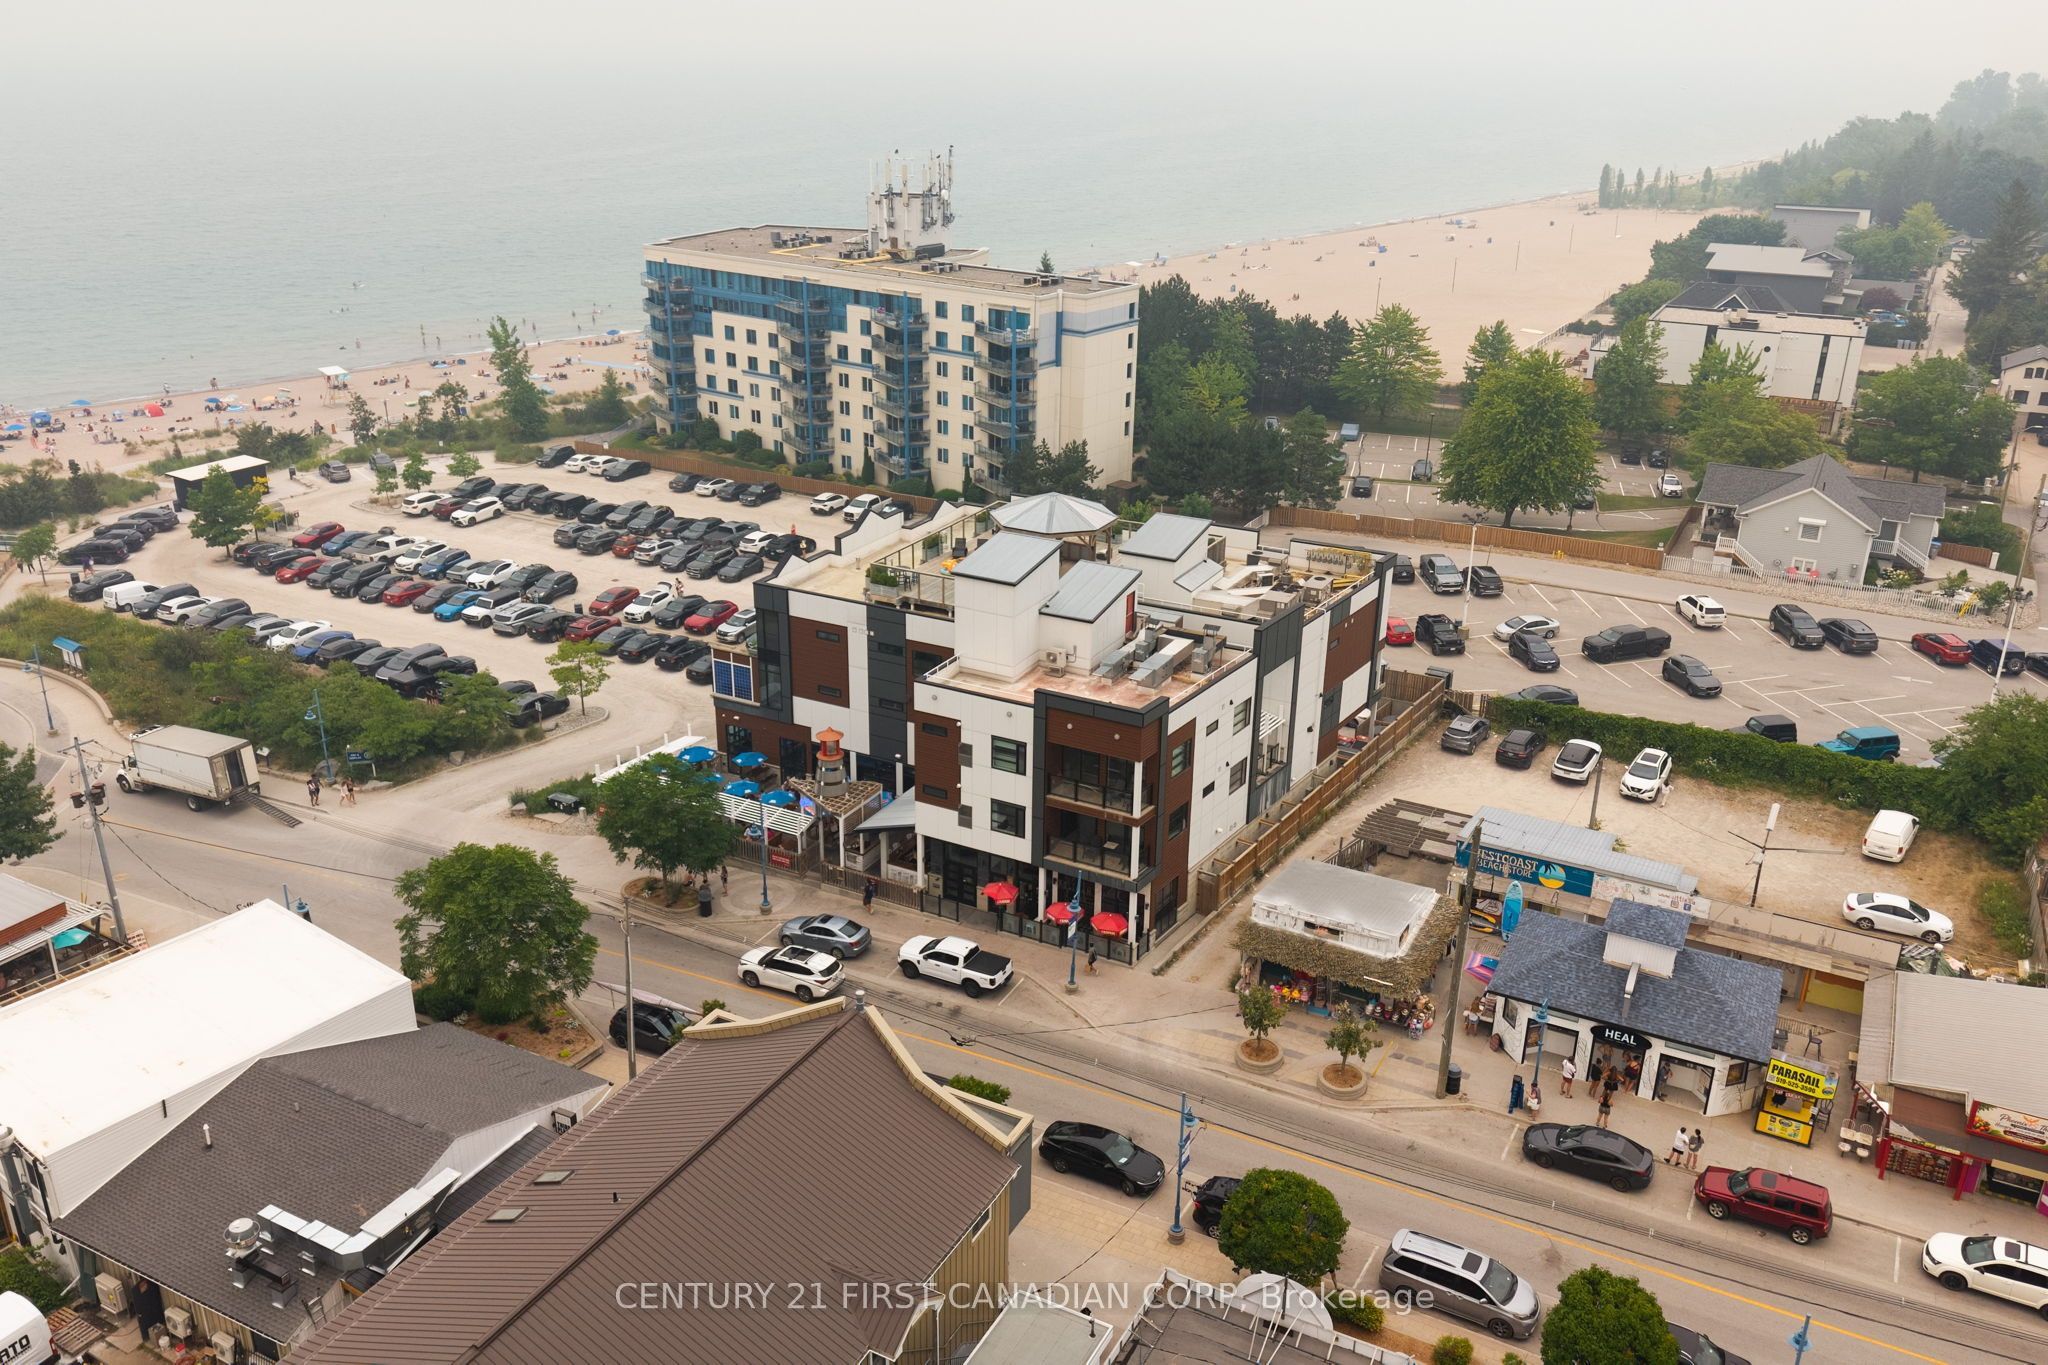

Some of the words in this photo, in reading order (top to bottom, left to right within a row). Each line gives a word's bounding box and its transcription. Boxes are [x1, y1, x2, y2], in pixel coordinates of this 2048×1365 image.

[1477, 848, 1538, 872] ESTCOAST
[1507, 864, 1533, 879] STORE
[1605, 1028, 1637, 1045] HEAL
[1771, 1063, 1820, 1089] PARASAIL
